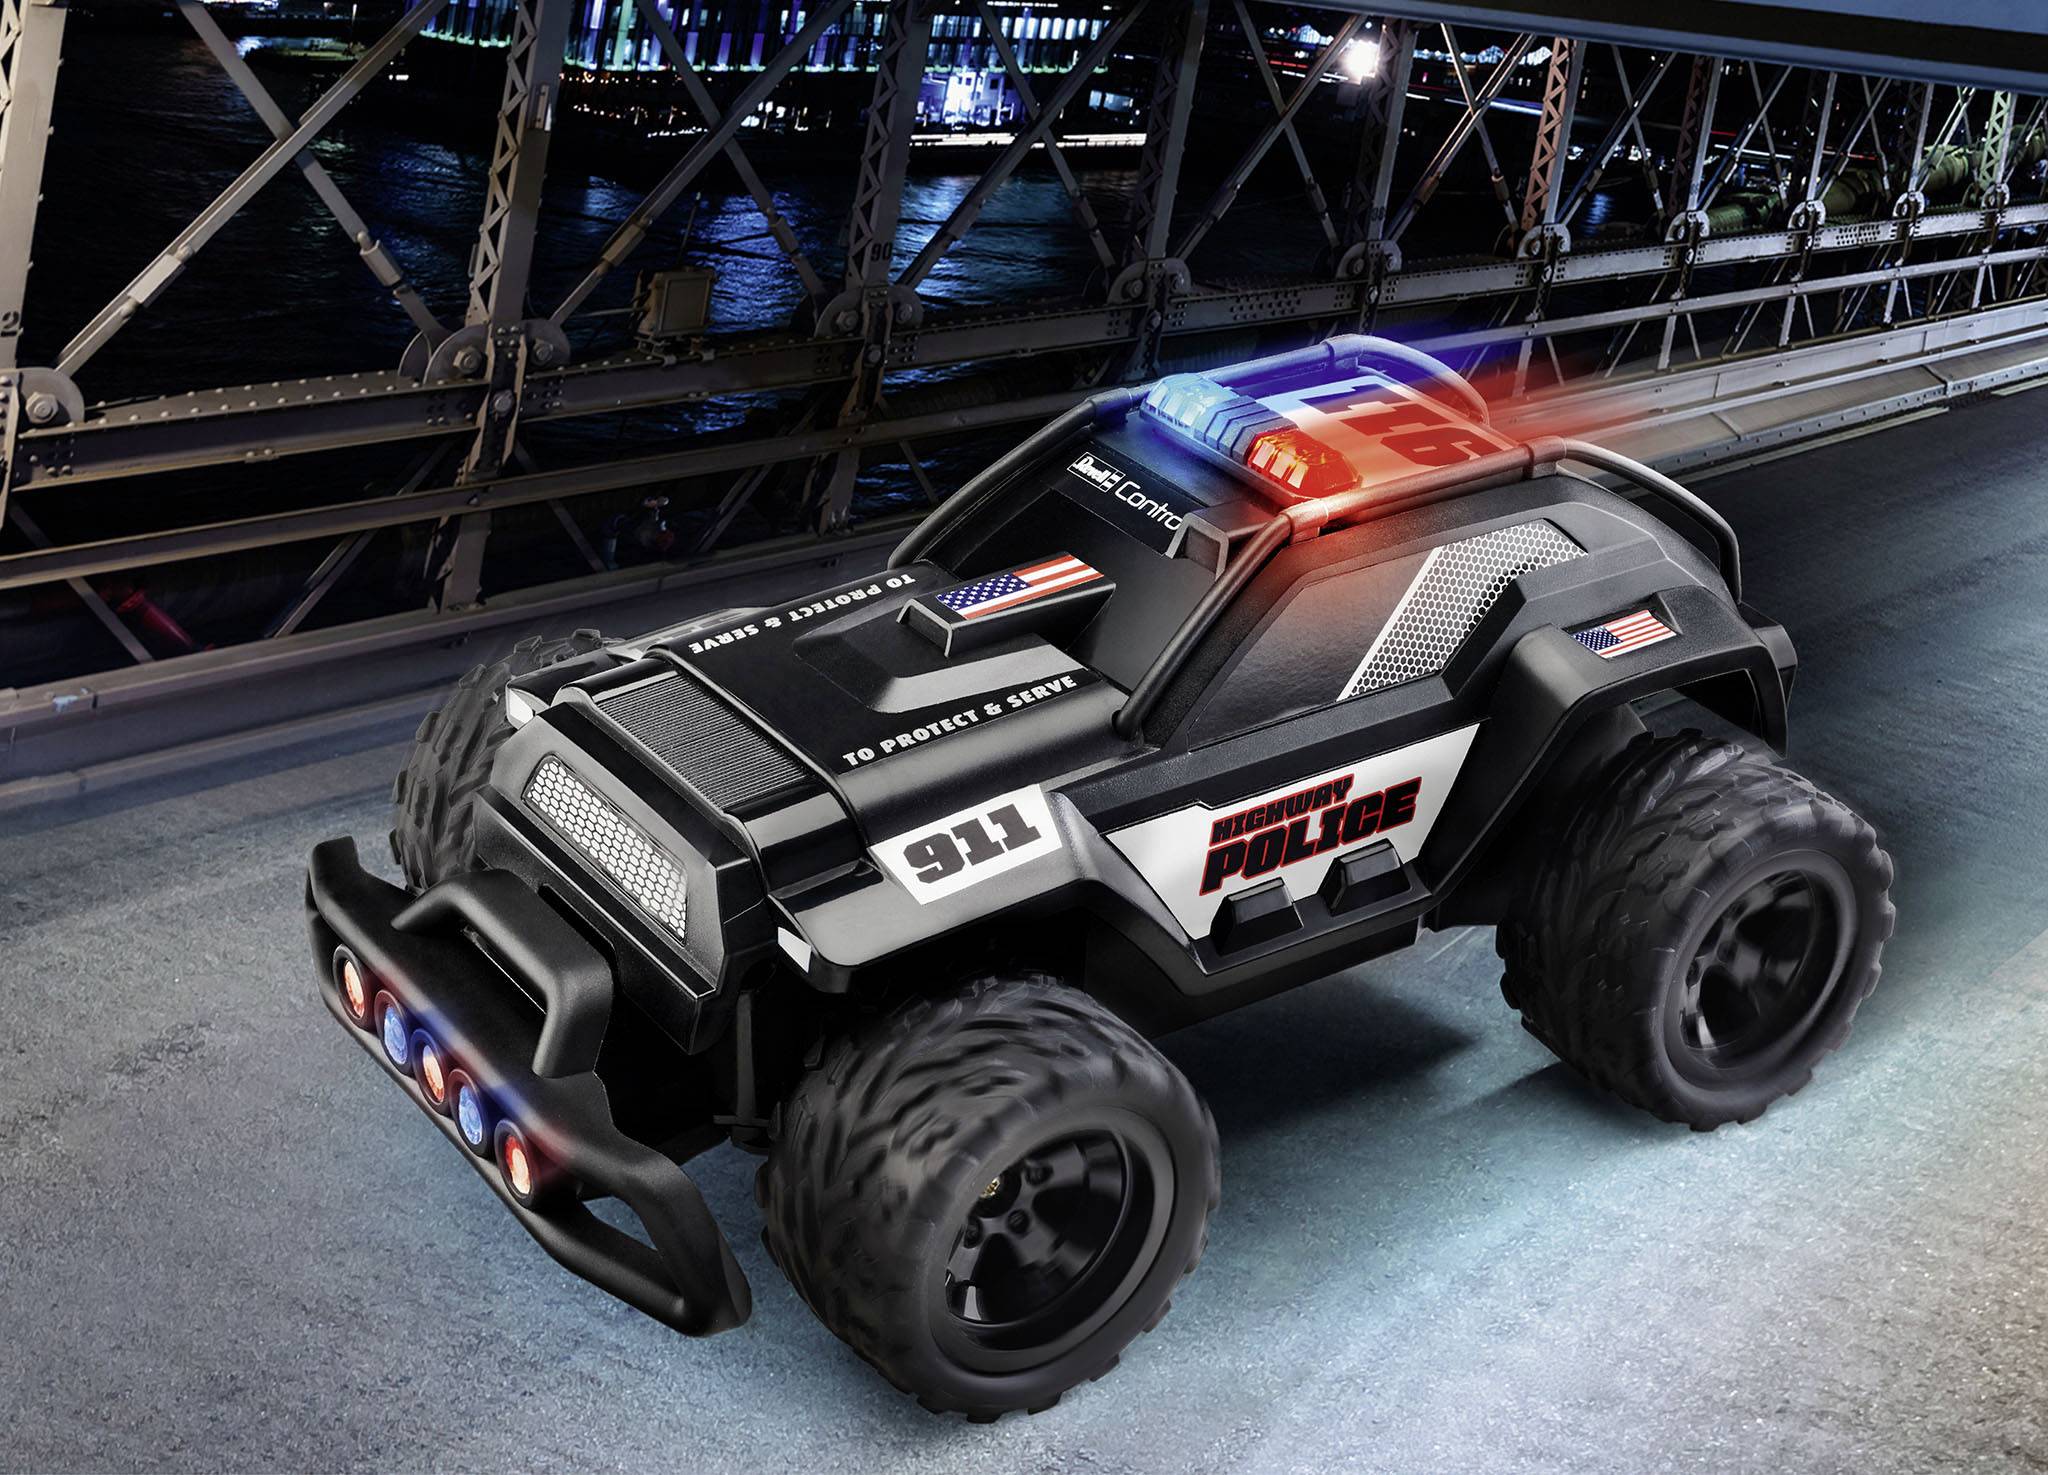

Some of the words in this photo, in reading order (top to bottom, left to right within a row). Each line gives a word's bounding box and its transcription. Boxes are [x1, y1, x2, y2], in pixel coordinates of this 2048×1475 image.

[871, 242, 893, 261] 90
[1299, 383, 1503, 467] 911
[1071, 455, 1113, 485] Revell
[1115, 480, 1184, 531] Contro
[788, 583, 883, 622] PROTECT
[886, 573, 916, 589] TO
[688, 623, 760, 655] SERVE
[764, 616, 782, 629] &
[842, 747, 875, 766] TO
[879, 709, 979, 754] PROTECT
[983, 702, 1003, 716] &
[1006, 675, 1077, 709] SERVE
[903, 803, 1042, 884] 911
[1199, 776, 1422, 896] POLICE
[1209, 773, 1355, 847] HIGHWAY
